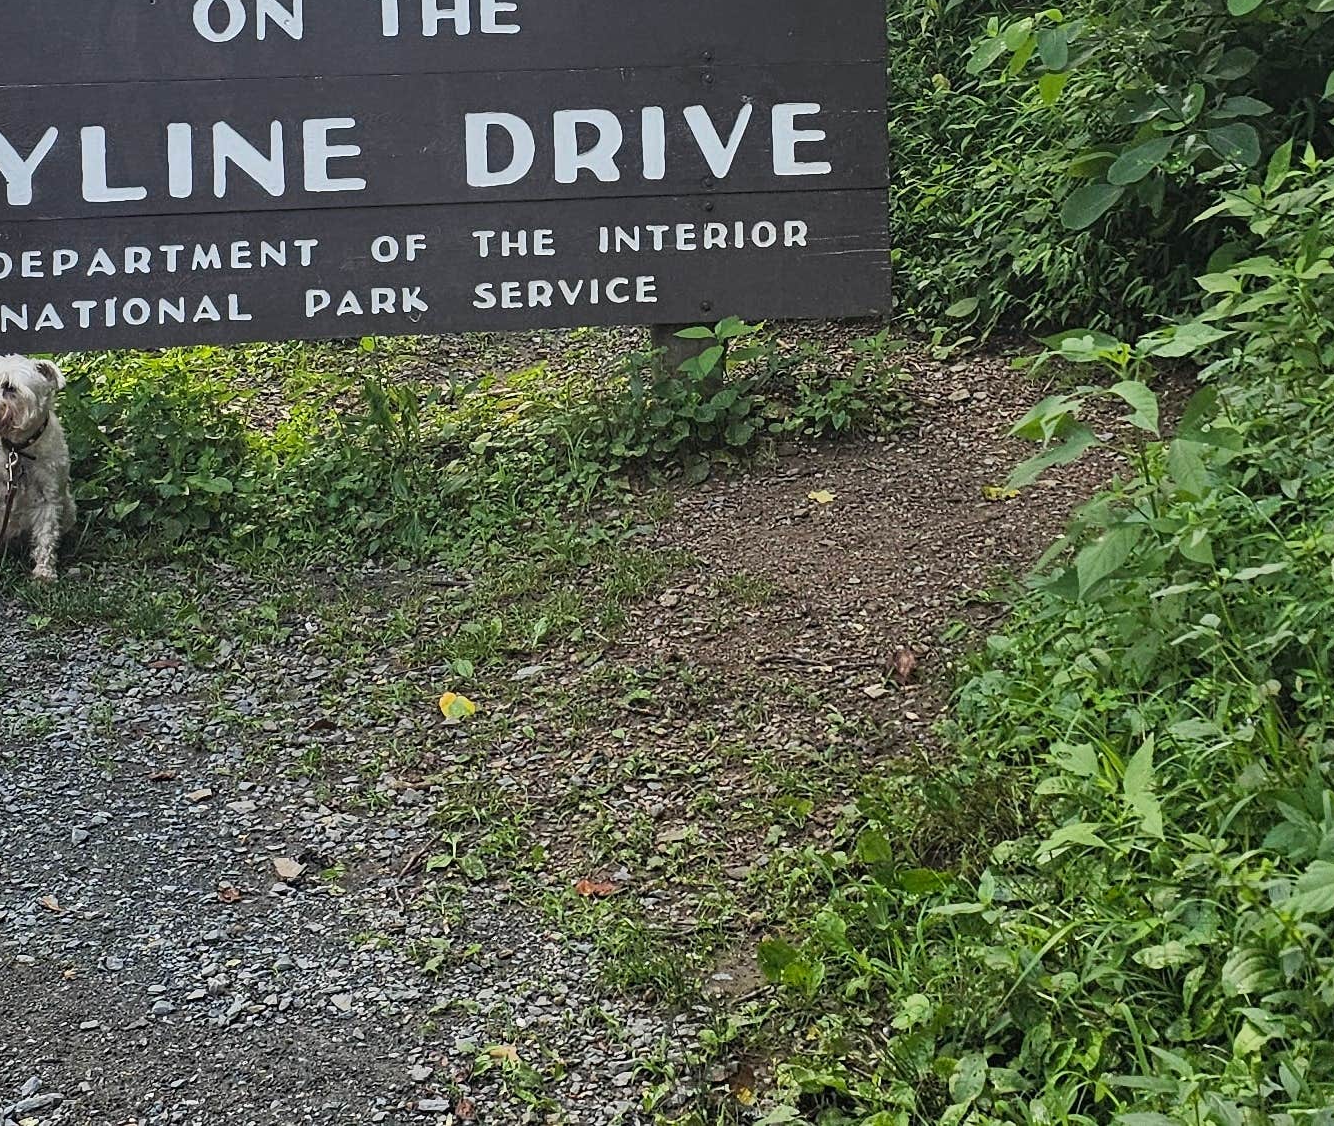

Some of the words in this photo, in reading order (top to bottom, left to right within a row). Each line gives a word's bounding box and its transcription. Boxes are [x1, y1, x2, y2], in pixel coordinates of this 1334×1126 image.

[464, 101, 833, 188] DRIVE
[370, 233, 428, 263] OF
[471, 228, 556, 258] THE
[598, 220, 809, 255] INTERIOR
[0, 293, 254, 334] NATIONAL
[304, 286, 430, 319] PARK
[472, 274, 659, 310] SERVICE
